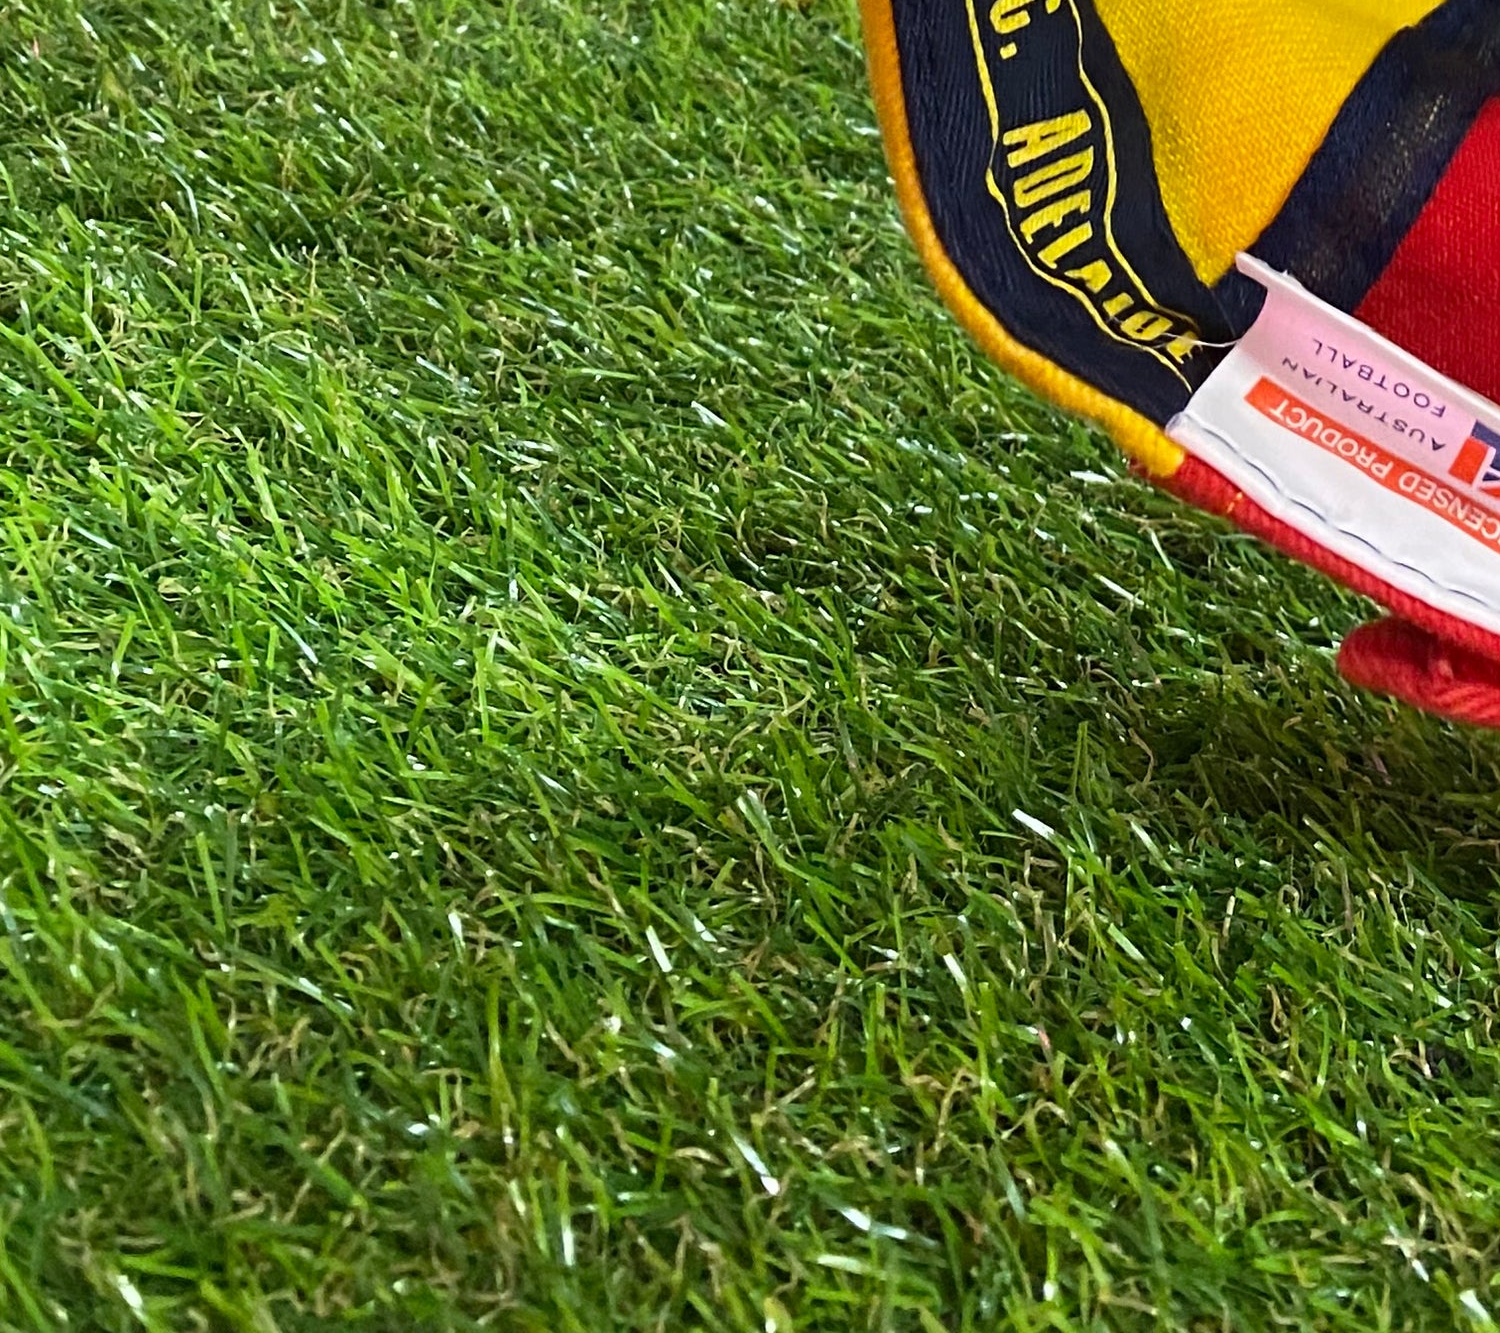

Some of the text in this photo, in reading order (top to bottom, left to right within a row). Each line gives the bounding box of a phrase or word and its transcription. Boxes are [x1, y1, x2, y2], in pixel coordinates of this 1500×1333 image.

[1281, 356, 1447, 452] AUSTRALIAN
[1312, 337, 1447, 419] FOOTBALL
[1268, 398, 1393, 480] PRODUCT
